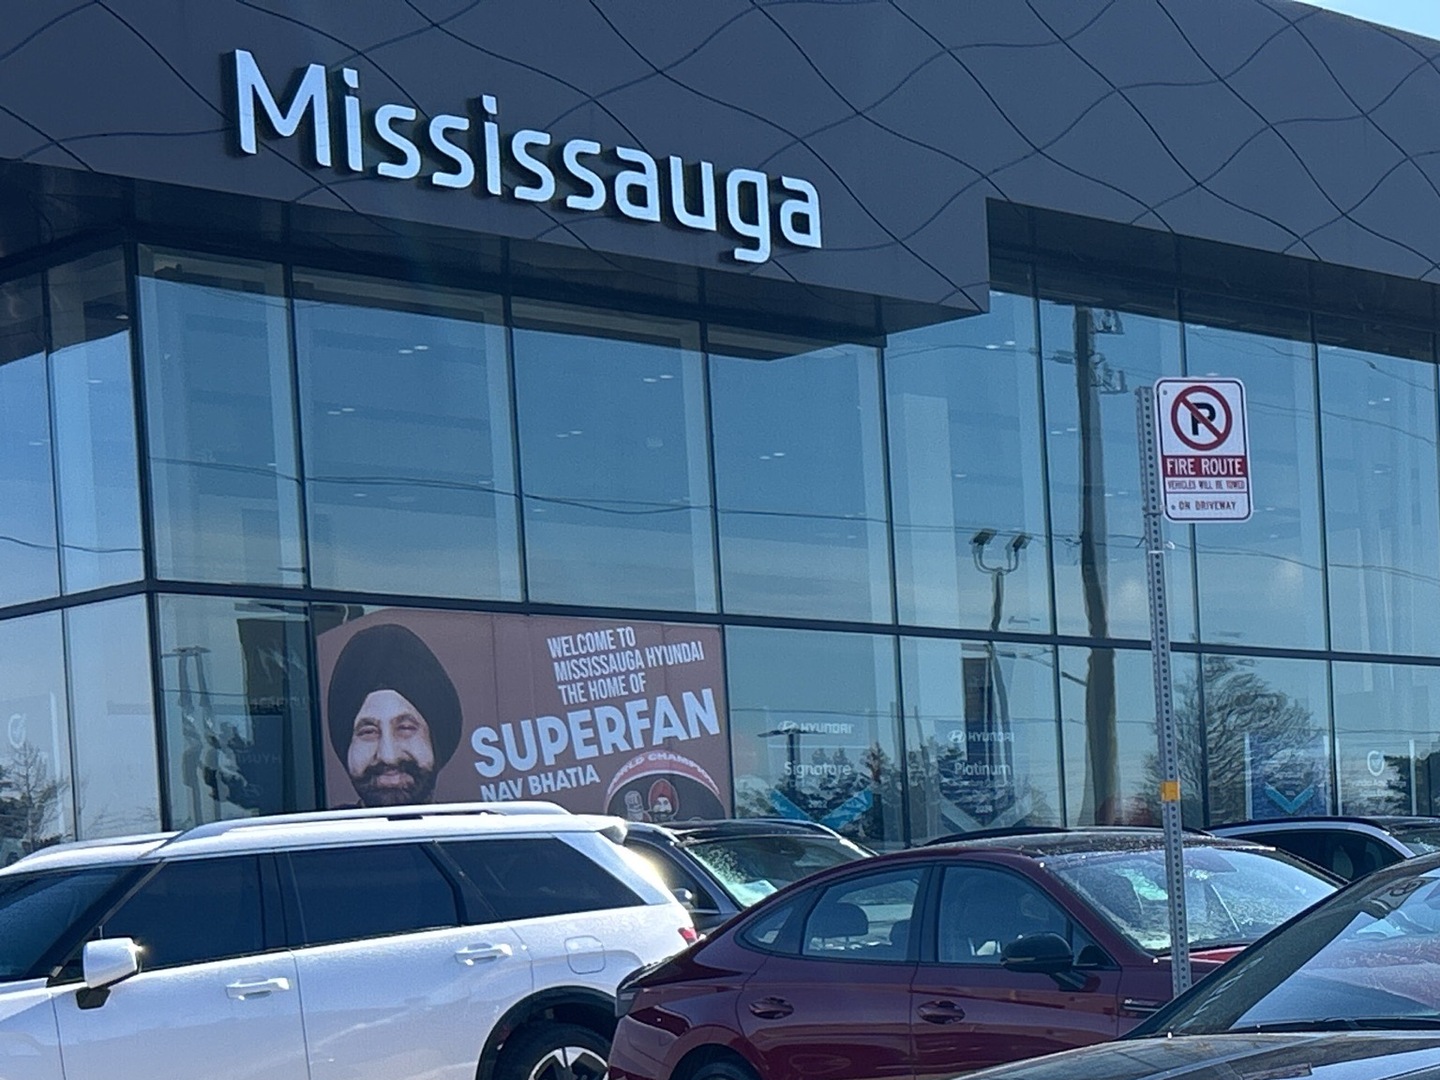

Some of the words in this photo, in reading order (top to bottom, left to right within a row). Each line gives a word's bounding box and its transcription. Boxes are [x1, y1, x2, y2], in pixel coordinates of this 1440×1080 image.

[234, 48, 823, 264] Mississauga
[1166, 458, 1196, 476] FIRE
[1201, 458, 1245, 476] ROUTE
[1167, 480, 1197, 490] VEHICLES
[1198, 480, 1213, 490] WILL
[1226, 480, 1246, 490] TOWED
[1178, 501, 1191, 511] ON
[1195, 501, 1237, 511] DRIVEWAY
[547, 628, 616, 659] WELCOME
[616, 626, 637, 648] TO
[553, 649, 645, 682] MISSISSAUGA
[646, 641, 705, 668] HYUNDAI
[558, 682, 588, 706] THE
[588, 675, 629, 701] HOME
[629, 672, 647, 694] OF
[471, 687, 721, 778] SUPERFAN
[480, 777, 524, 803] NAV
[528, 764, 601, 796] BHATIA
[784, 761, 852, 778] Signature
[954, 761, 1012, 776] Platinum
